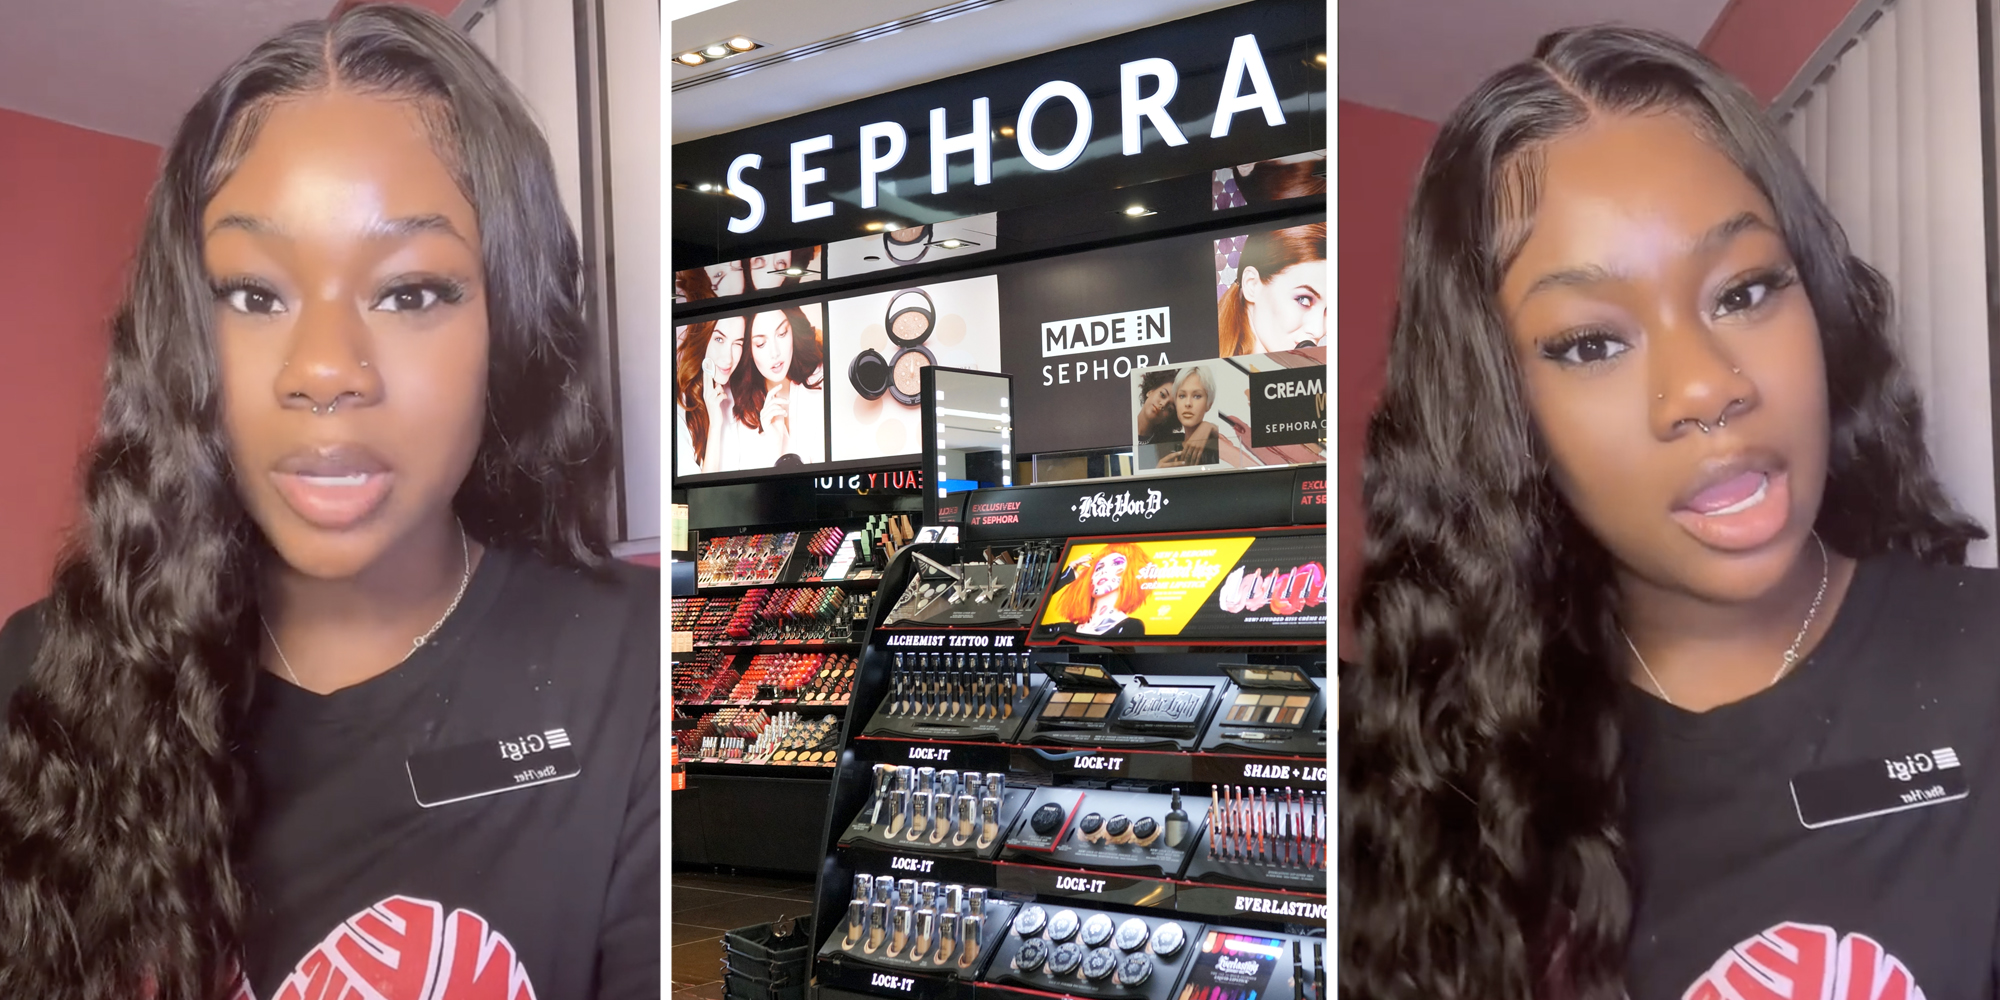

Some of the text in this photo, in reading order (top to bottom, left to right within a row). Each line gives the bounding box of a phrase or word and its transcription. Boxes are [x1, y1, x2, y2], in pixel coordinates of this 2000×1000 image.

[726, 34, 1287, 235] SEPHORA
[1045, 312, 1166, 352] MADE IN
[1264, 378, 1323, 400] CREAM
[1265, 421, 1318, 434] SEPHORA
[971, 501, 1021, 513] EXCLUSIVELY
[1079, 487, 1162, 523] Kat Von D
[1300, 495, 1313, 505] AT
[971, 514, 1019, 526] AT SEPHORA
[886, 635, 1015, 647] ALCHEMIST TATTOO INK
[908, 747, 951, 761] LOCK-IT
[1073, 755, 1123, 771] LOCK-IT
[1243, 763, 1290, 780] SHADE
[891, 856, 934, 873] LOCK-IT
[1055, 875, 1106, 893] LOCK-IT
[871, 972, 915, 992] LOCK-IT
